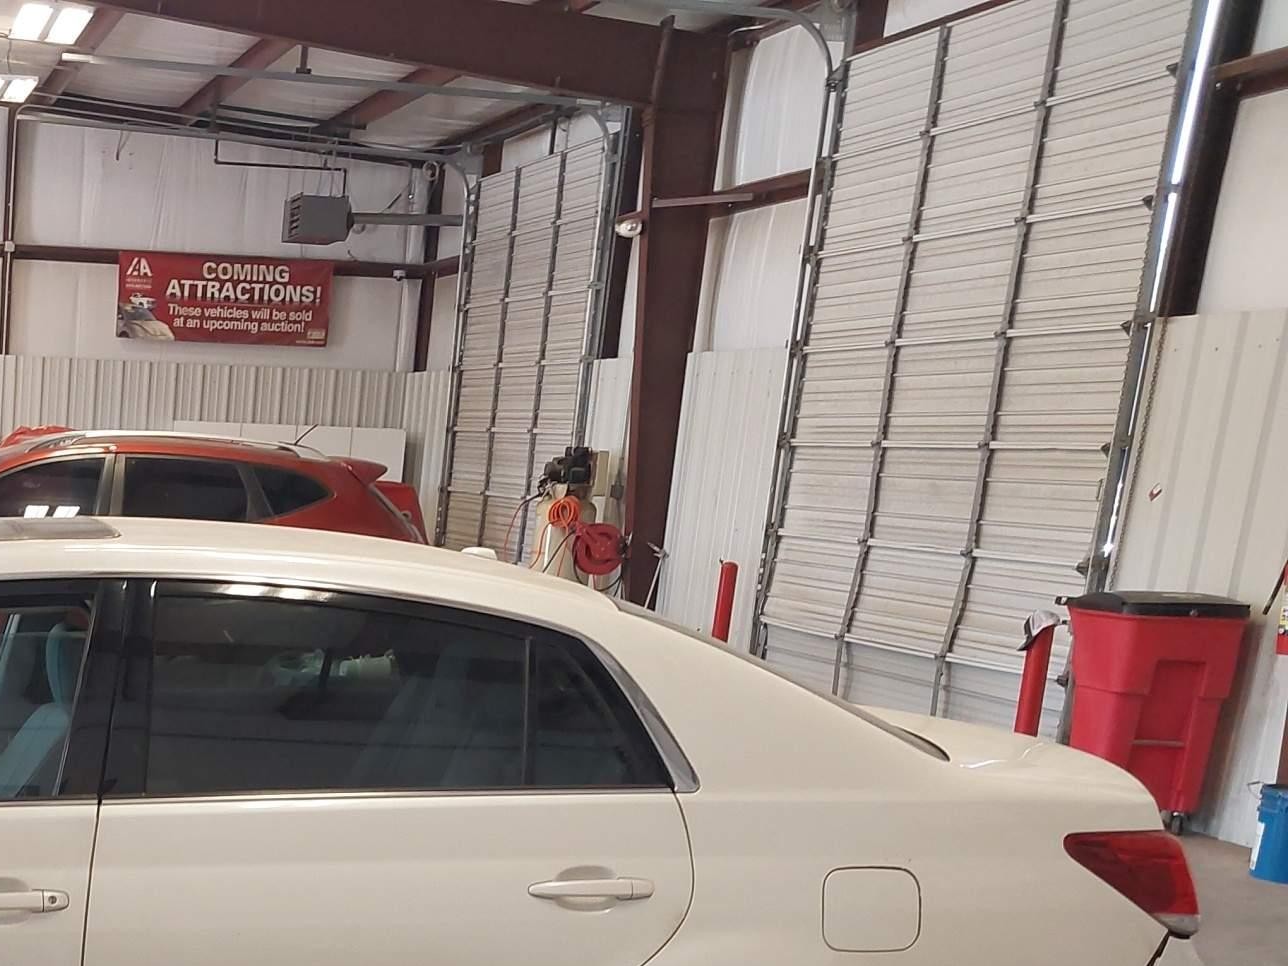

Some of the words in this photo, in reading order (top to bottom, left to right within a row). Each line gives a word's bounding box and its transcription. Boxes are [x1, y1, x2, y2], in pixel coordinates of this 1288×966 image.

[202, 261, 290, 283] COMING
[165, 279, 322, 303] ATTRACTIONS!
[167, 303, 202, 316] These
[203, 306, 249, 319] vehicles
[251, 308, 271, 320] will
[272, 308, 287, 320] be
[289, 310, 313, 322] sold
[172, 316, 184, 328] at
[186, 318, 201, 329] an
[203, 319, 259, 334] upcoming
[260, 321, 305, 333] auction!
